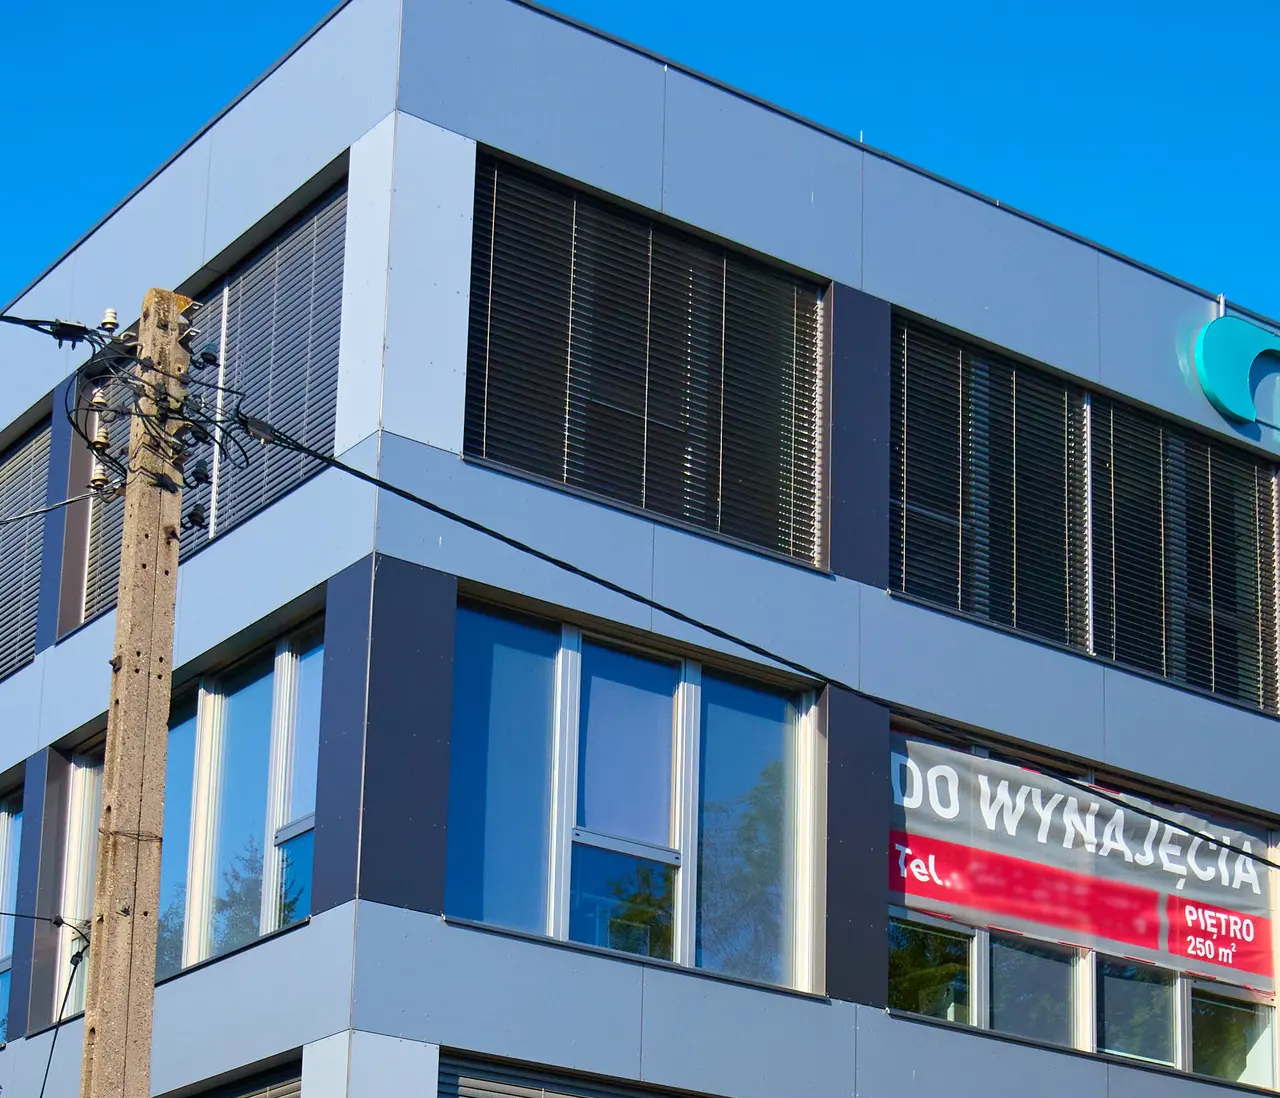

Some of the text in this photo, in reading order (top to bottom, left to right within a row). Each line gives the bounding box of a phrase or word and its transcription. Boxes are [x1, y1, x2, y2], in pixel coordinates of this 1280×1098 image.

[890, 751, 1261, 895] DO WYNAJĘCIA
[1185, 905, 1255, 942] PIĘTRO
[1186, 935, 1215, 959] 250
